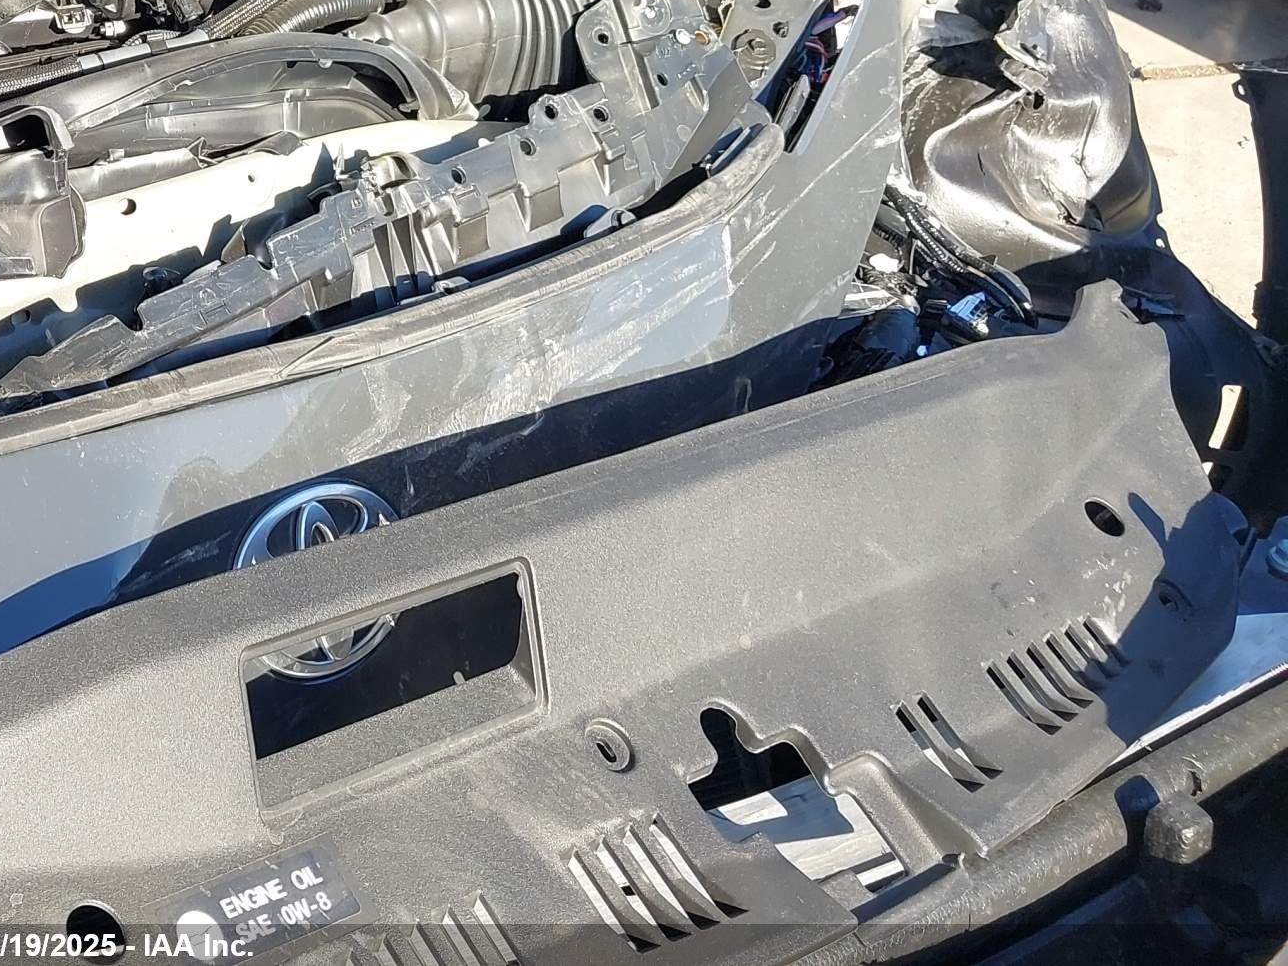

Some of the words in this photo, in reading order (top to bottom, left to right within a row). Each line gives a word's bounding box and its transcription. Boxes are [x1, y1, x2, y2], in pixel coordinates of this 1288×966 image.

[219, 878, 288, 919] ENGINE
[290, 866, 323, 889] OIL
[235, 913, 276, 943] SAE
[280, 891, 332, 925] 0W-8
